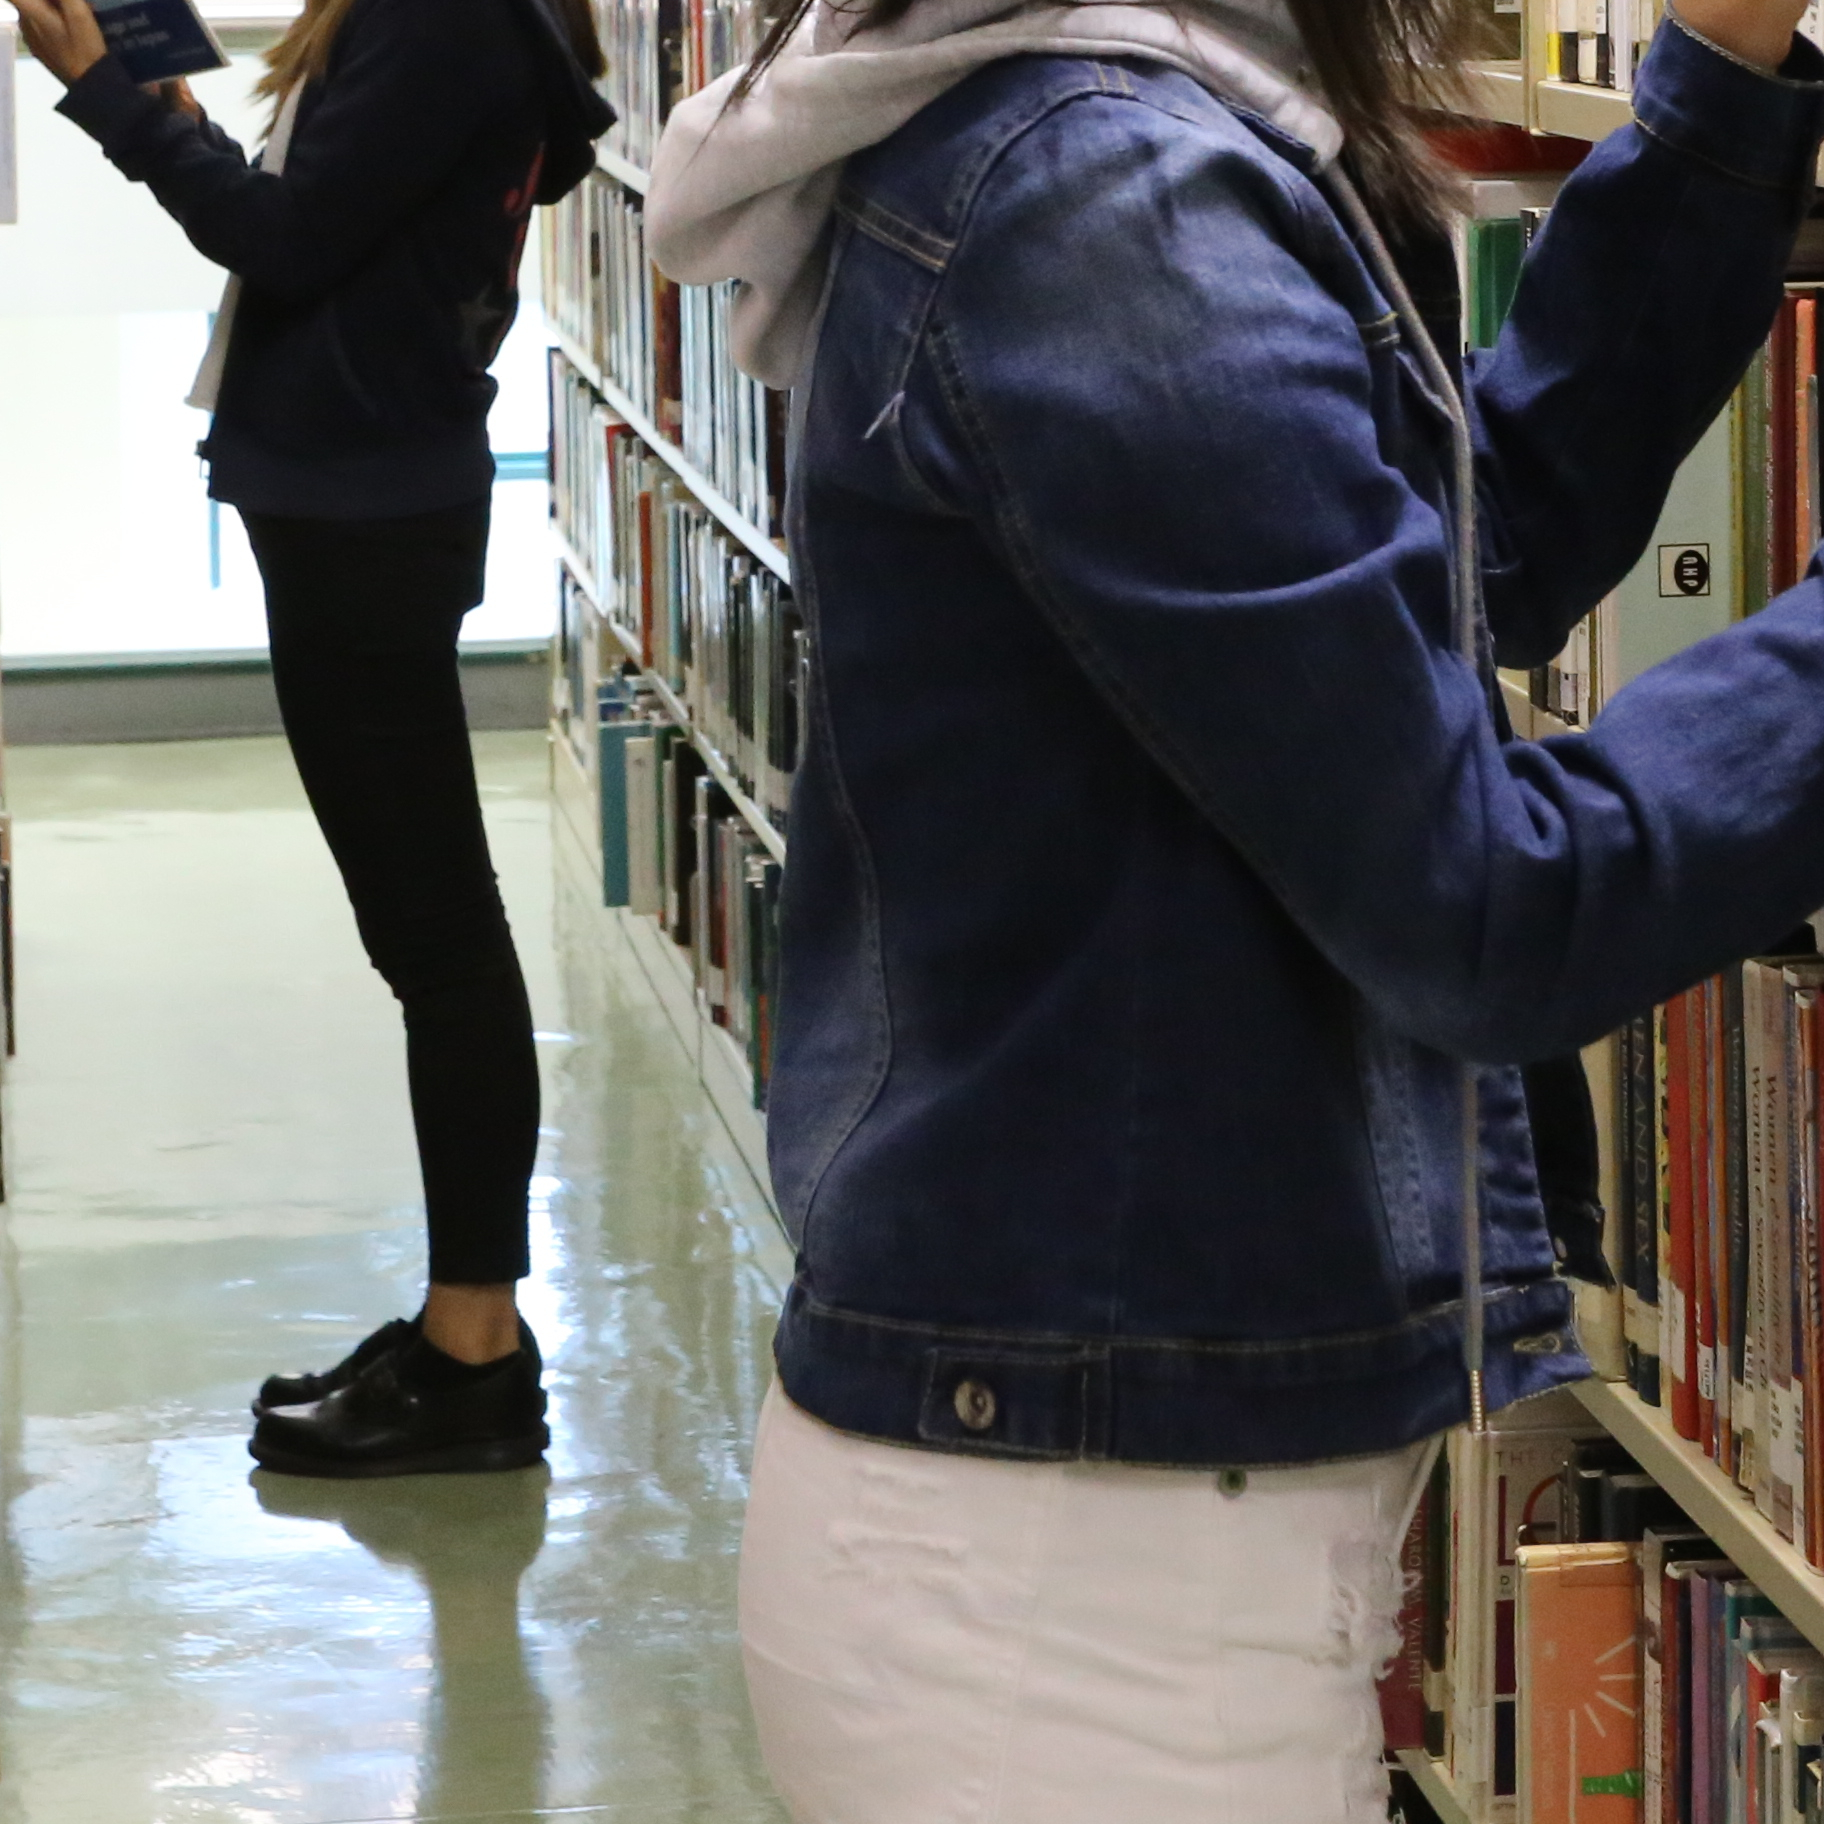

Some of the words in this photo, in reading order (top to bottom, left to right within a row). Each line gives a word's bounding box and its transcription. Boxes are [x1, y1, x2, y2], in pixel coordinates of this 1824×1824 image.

[1632, 1087, 1651, 1174] AND
[1751, 1065, 1763, 1176] Women
[1765, 1074, 1779, 1185] Women
[1636, 1197, 1652, 1264] SEX
